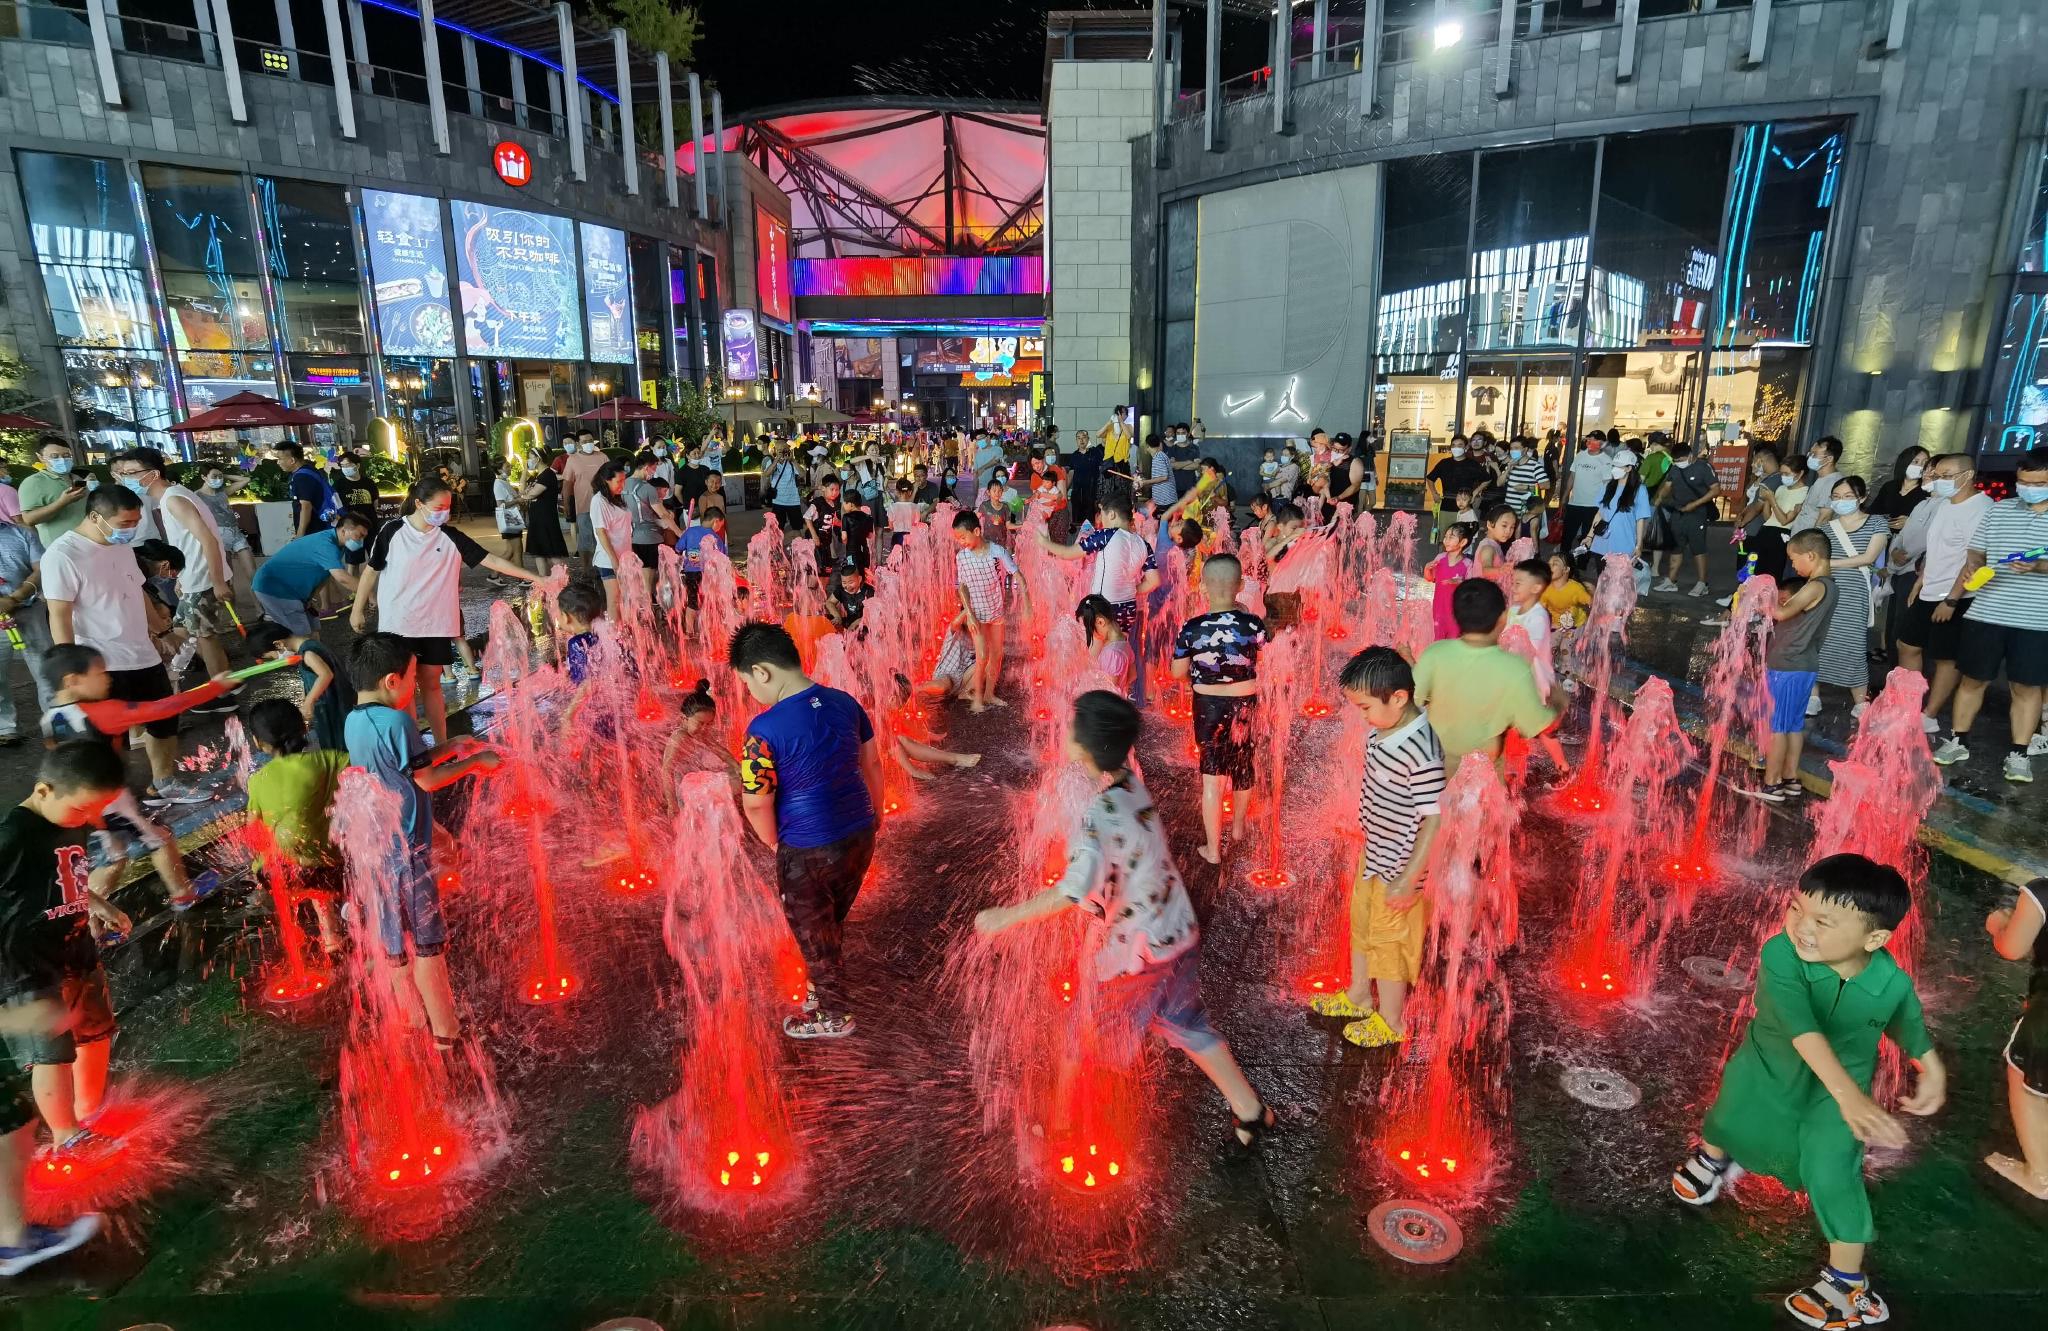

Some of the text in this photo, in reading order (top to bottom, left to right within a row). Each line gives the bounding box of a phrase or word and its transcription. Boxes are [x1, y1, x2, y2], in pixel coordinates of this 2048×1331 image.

[376, 230, 435, 249] 轻食工厂
[485, 226, 551, 249] 吸引你的
[495, 246, 561, 265] 不只咖啡
